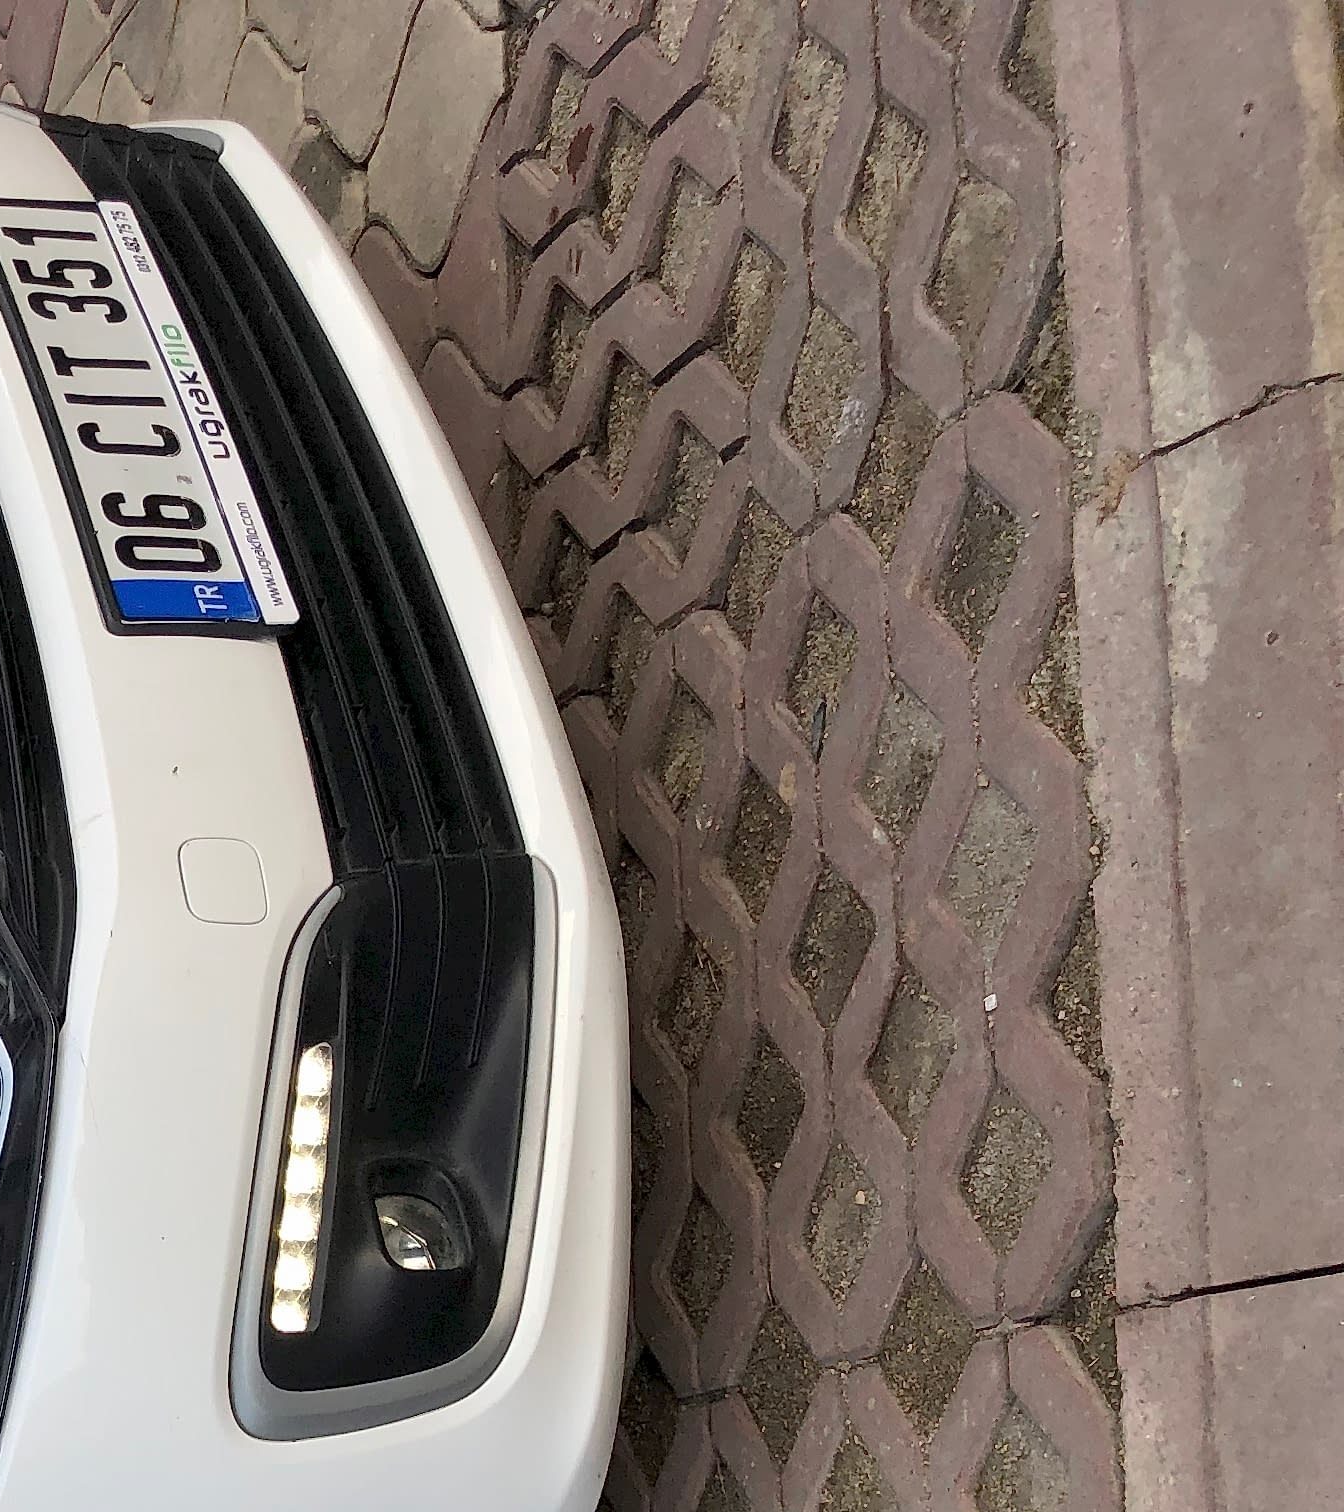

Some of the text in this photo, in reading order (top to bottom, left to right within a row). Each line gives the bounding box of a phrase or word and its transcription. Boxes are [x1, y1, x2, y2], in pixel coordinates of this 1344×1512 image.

[1, 226, 228, 614] TR 06 CIT 351
